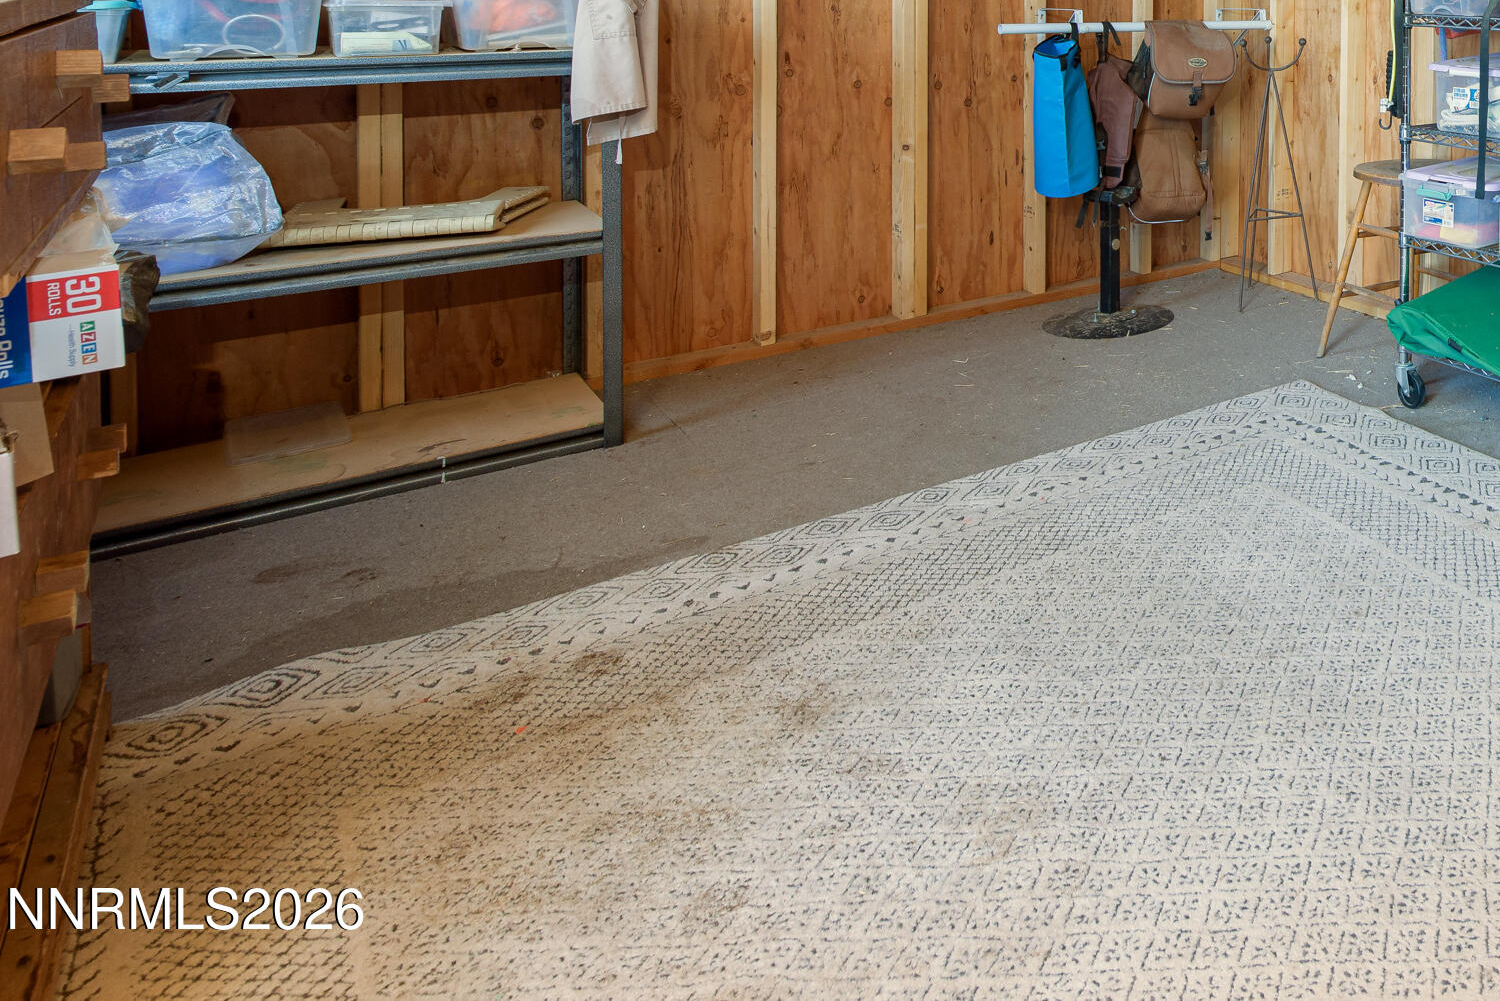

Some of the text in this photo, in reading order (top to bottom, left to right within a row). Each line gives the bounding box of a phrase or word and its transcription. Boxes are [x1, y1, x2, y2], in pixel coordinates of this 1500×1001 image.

[47, 282, 62, 316] ROLLS
[65, 276, 102, 314] 30
[80, 321, 98, 365] AZEN
